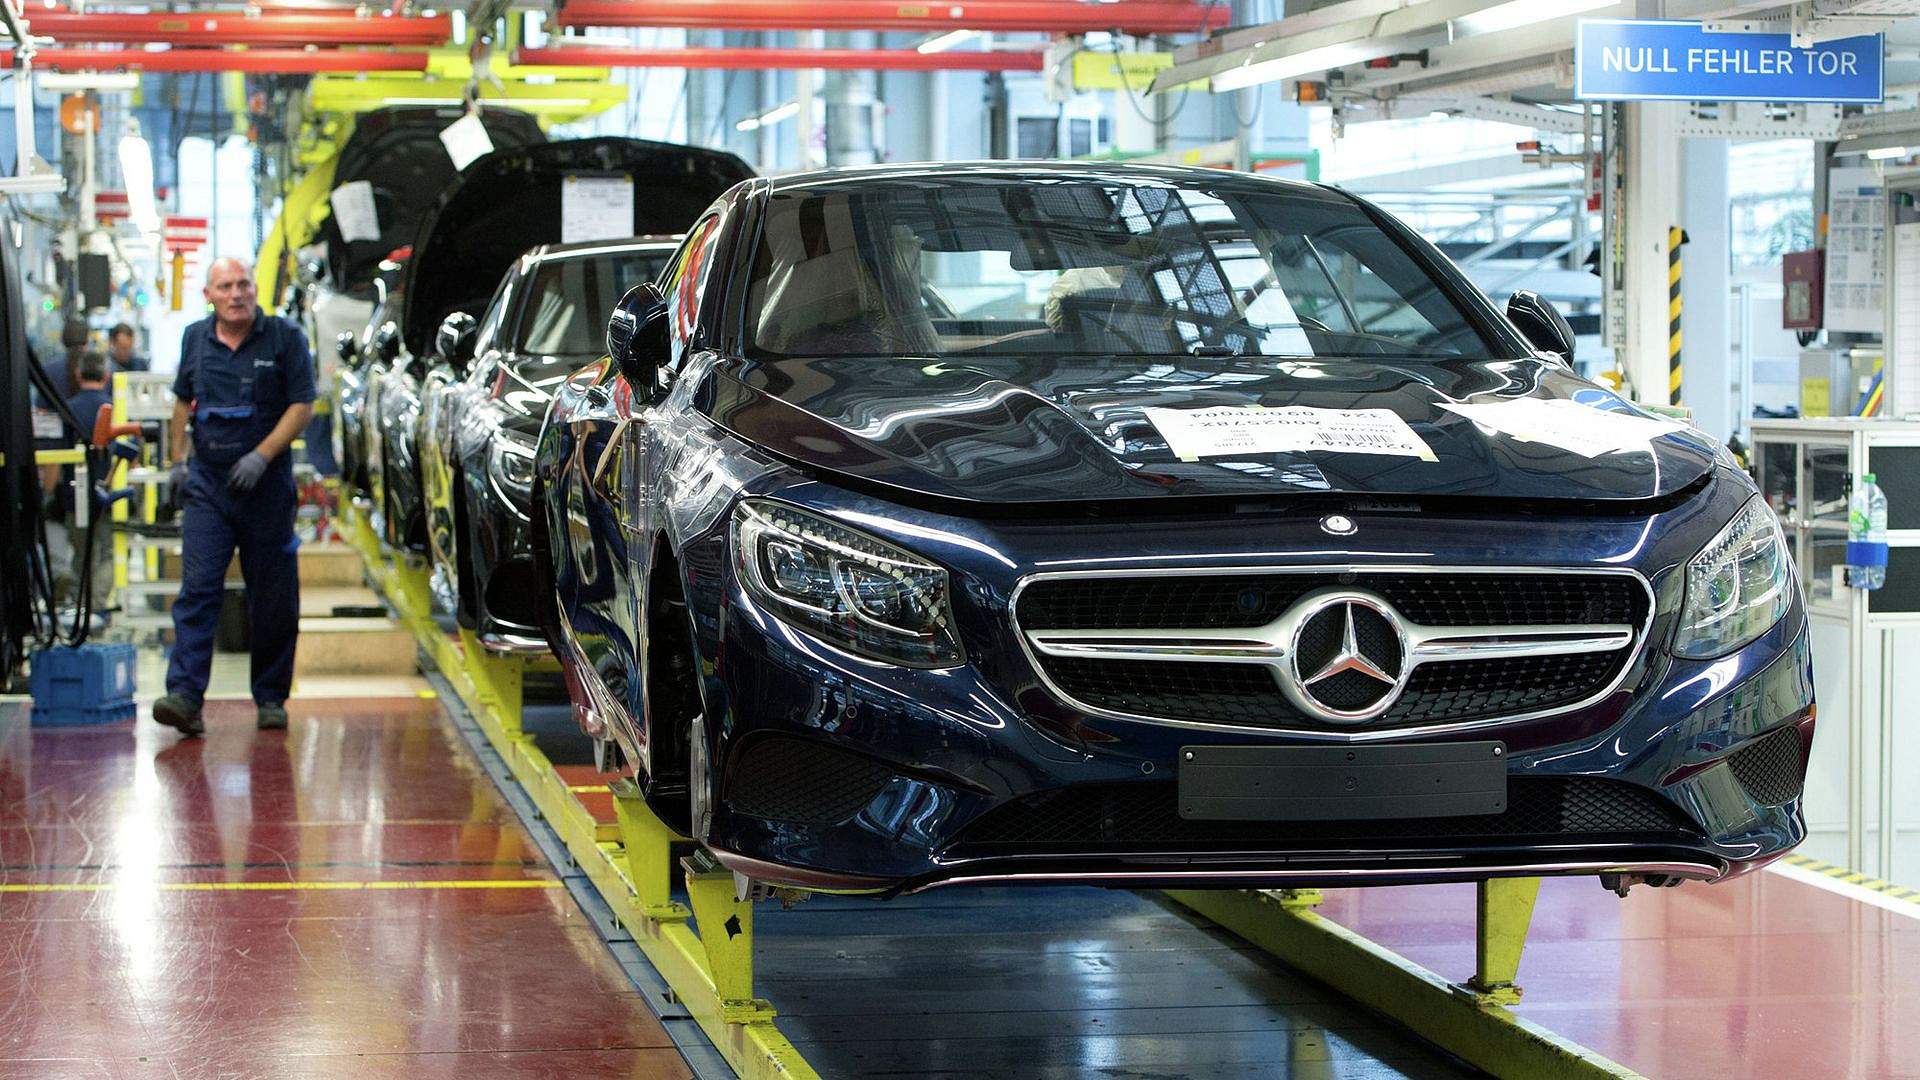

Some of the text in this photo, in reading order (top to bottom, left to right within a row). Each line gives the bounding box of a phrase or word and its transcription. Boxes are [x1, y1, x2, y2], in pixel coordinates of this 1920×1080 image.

[1602, 47, 1858, 75] NULL FEHLER TOR
